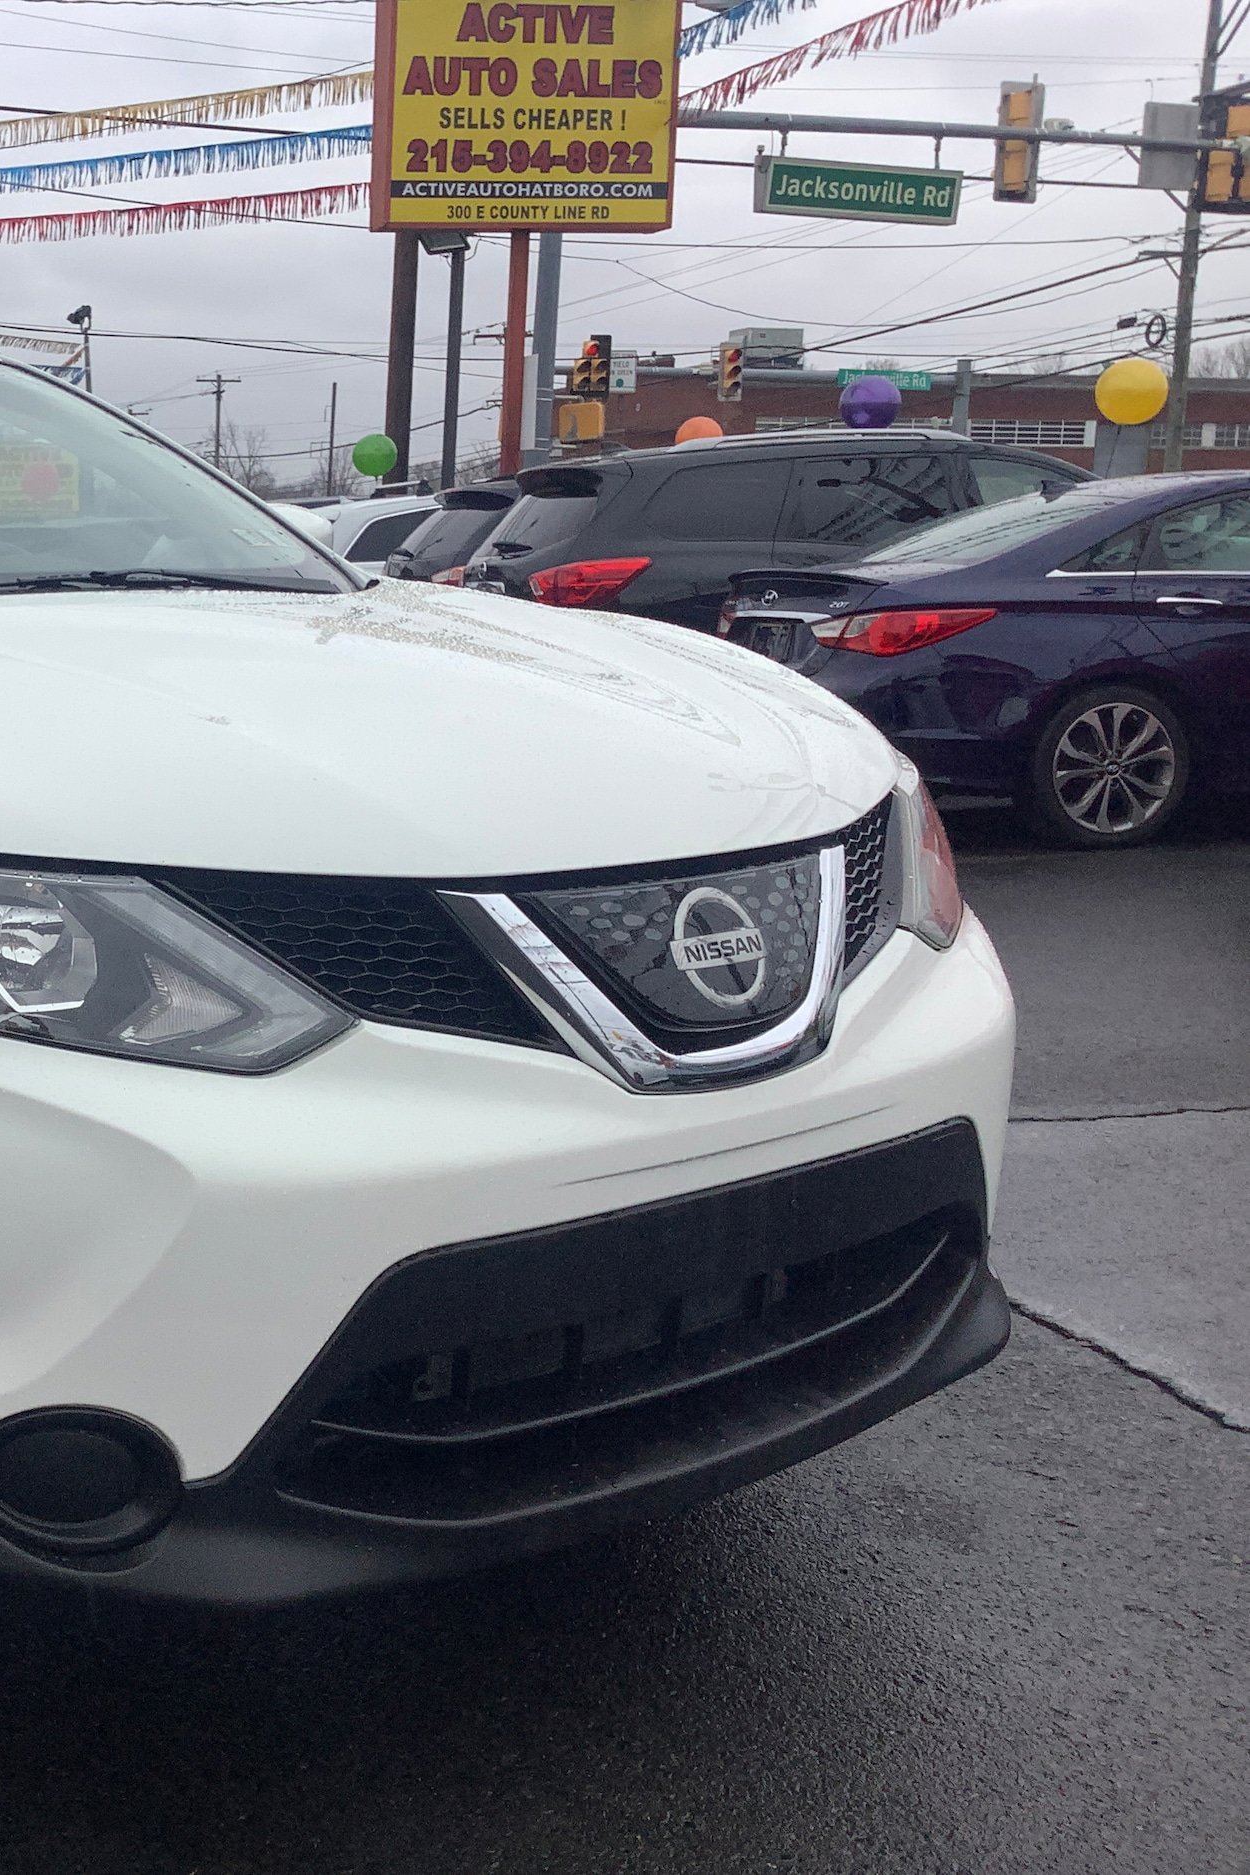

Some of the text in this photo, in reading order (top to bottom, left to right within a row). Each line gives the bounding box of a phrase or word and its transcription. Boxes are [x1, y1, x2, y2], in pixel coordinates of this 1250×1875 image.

[456, 2, 615, 45] ACTIVE
[402, 56, 663, 100] AUTO SALES
[439, 107, 505, 130] SELLS
[513, 108, 613, 131] CHEAPER
[406, 138, 653, 174] 215-394-8922
[401, 182, 653, 198] ACTIVEAUTOHATBORO.COM
[775, 173, 950, 208] Jacksonville Rd
[447, 205, 610, 220] 300 E COUNTY LINE RD
[912, 373, 926, 387] Rd
[683, 934, 762, 963] NISSAN
